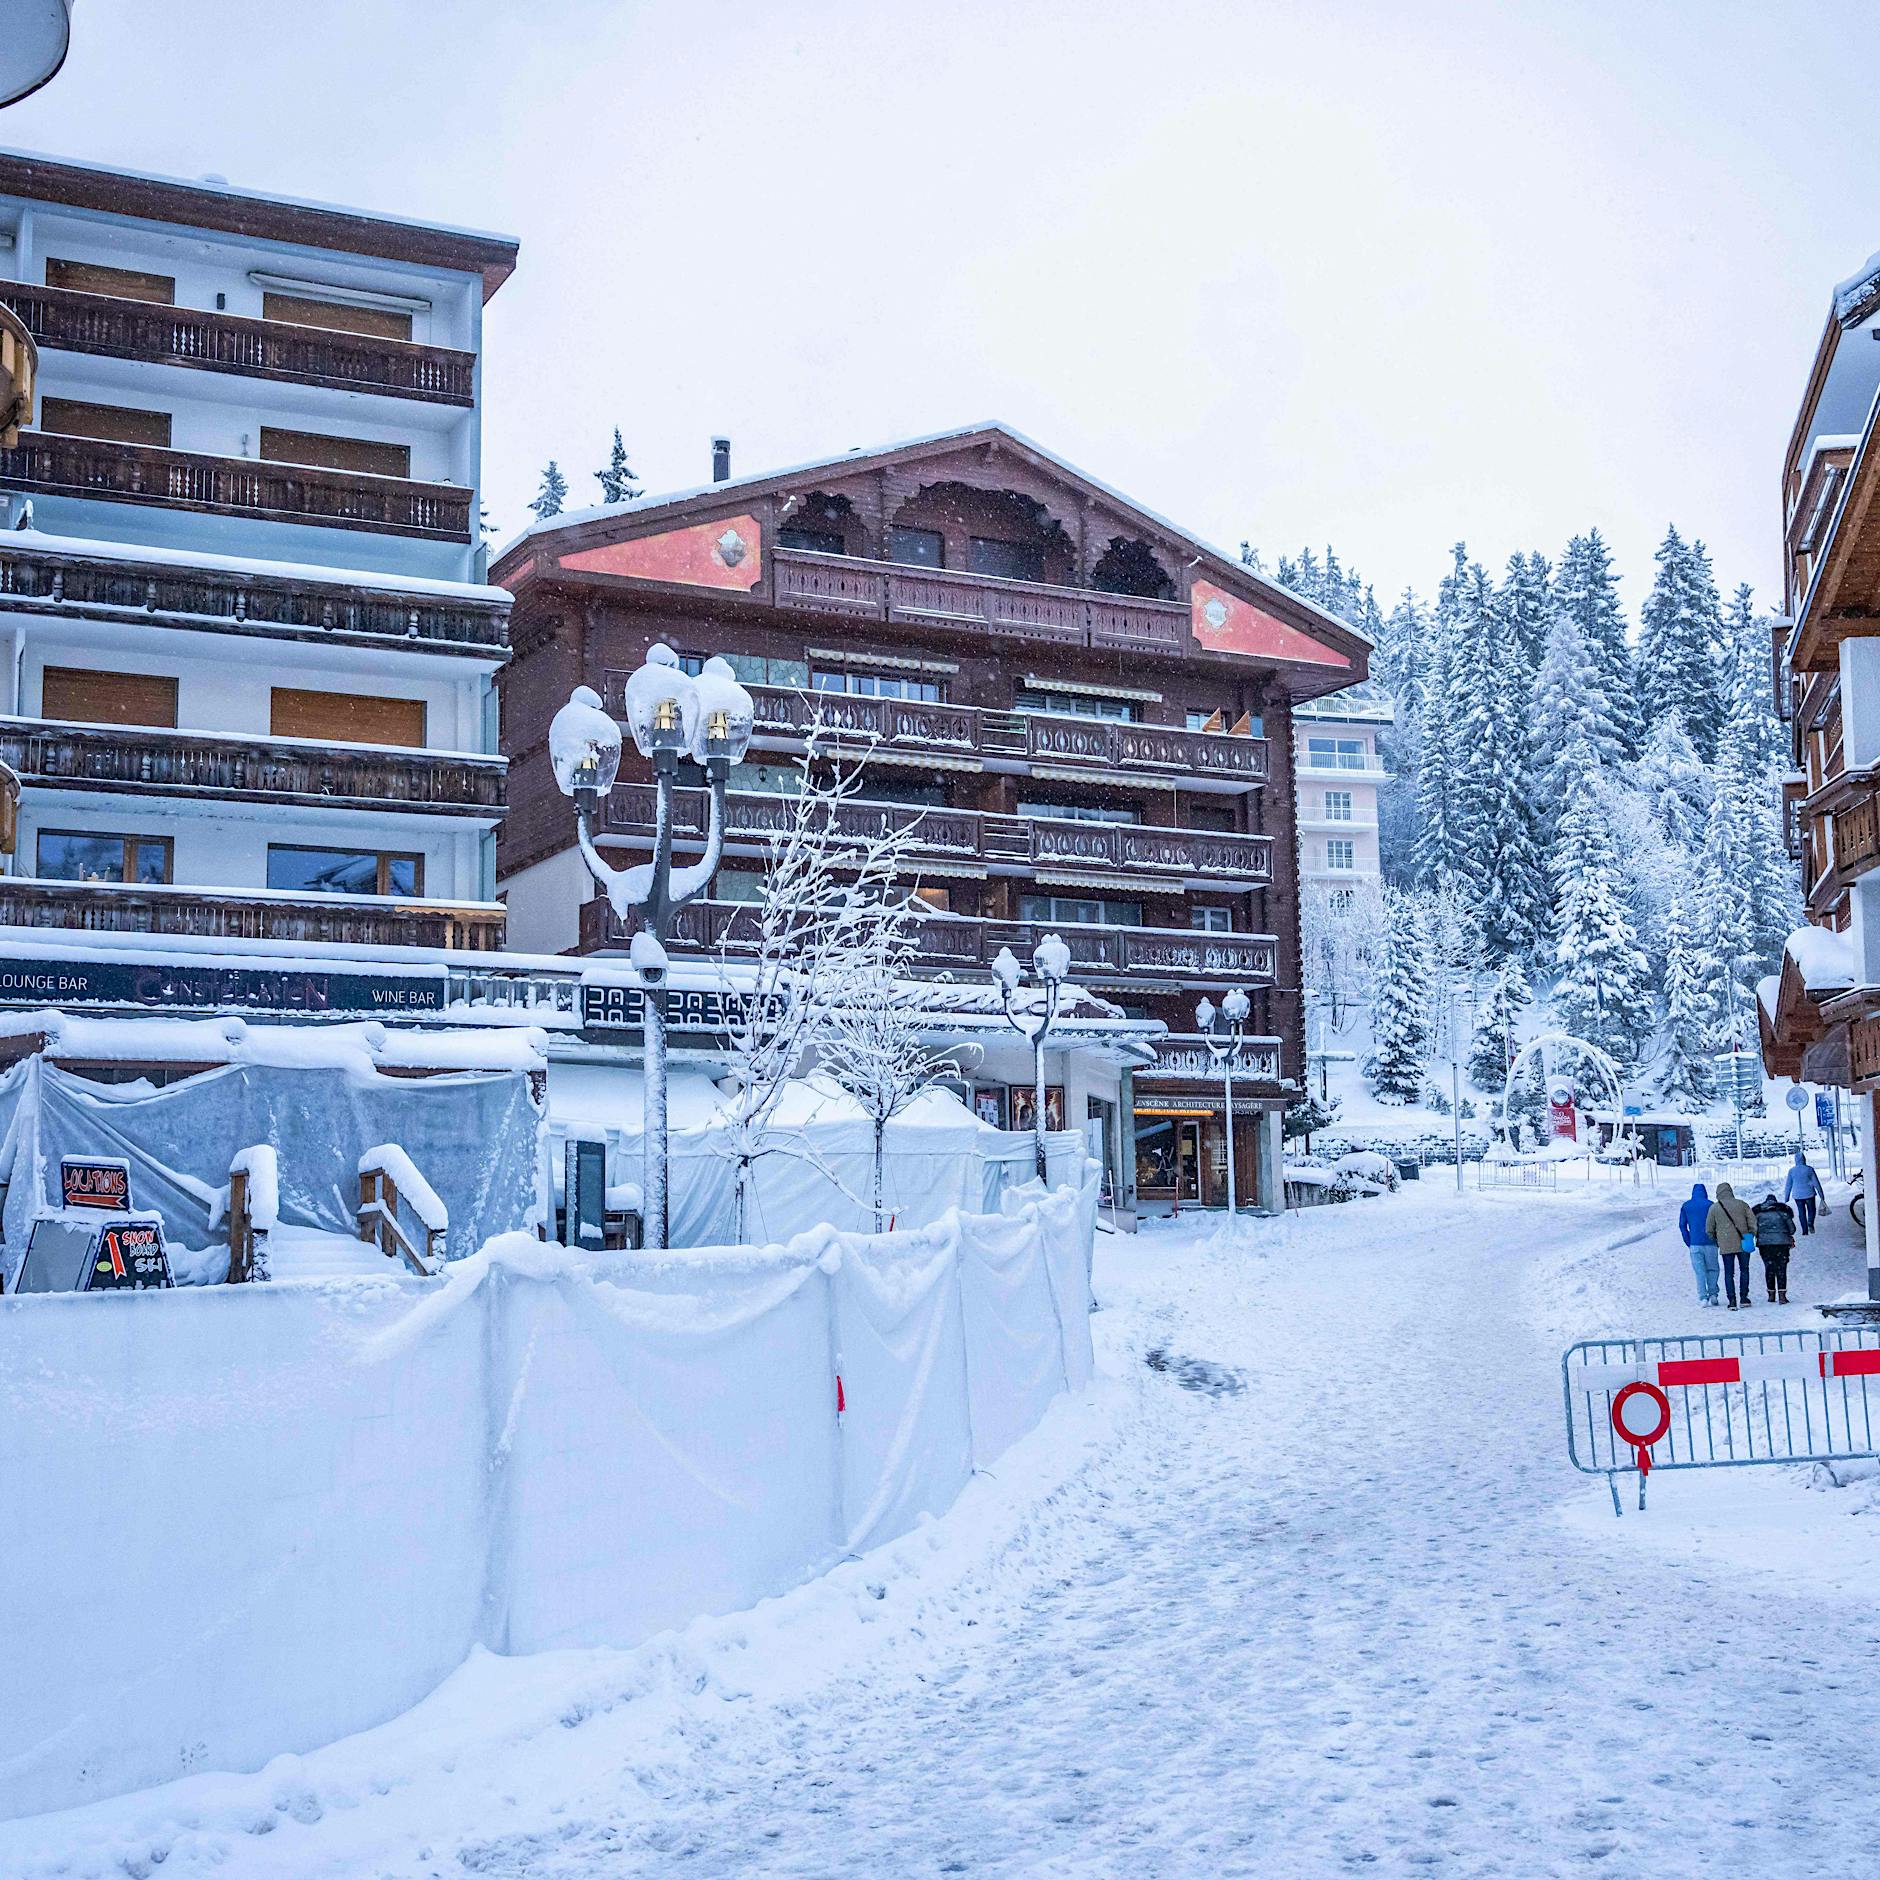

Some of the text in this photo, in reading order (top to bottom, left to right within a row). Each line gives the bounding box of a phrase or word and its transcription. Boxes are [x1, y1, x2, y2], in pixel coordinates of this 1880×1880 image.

[0, 973, 88, 991] OUNGE BAR
[372, 989, 435, 1005] WINE BAR
[1172, 1101, 1225, 1110] ARCHITECTURE
[1230, 1102, 1263, 1110] AYSAGÈRE
[64, 1168, 126, 1194] LOCATIONS
[121, 1230, 155, 1245] SNOW
[129, 1243, 159, 1257] BOARD
[134, 1257, 163, 1273] SKI
